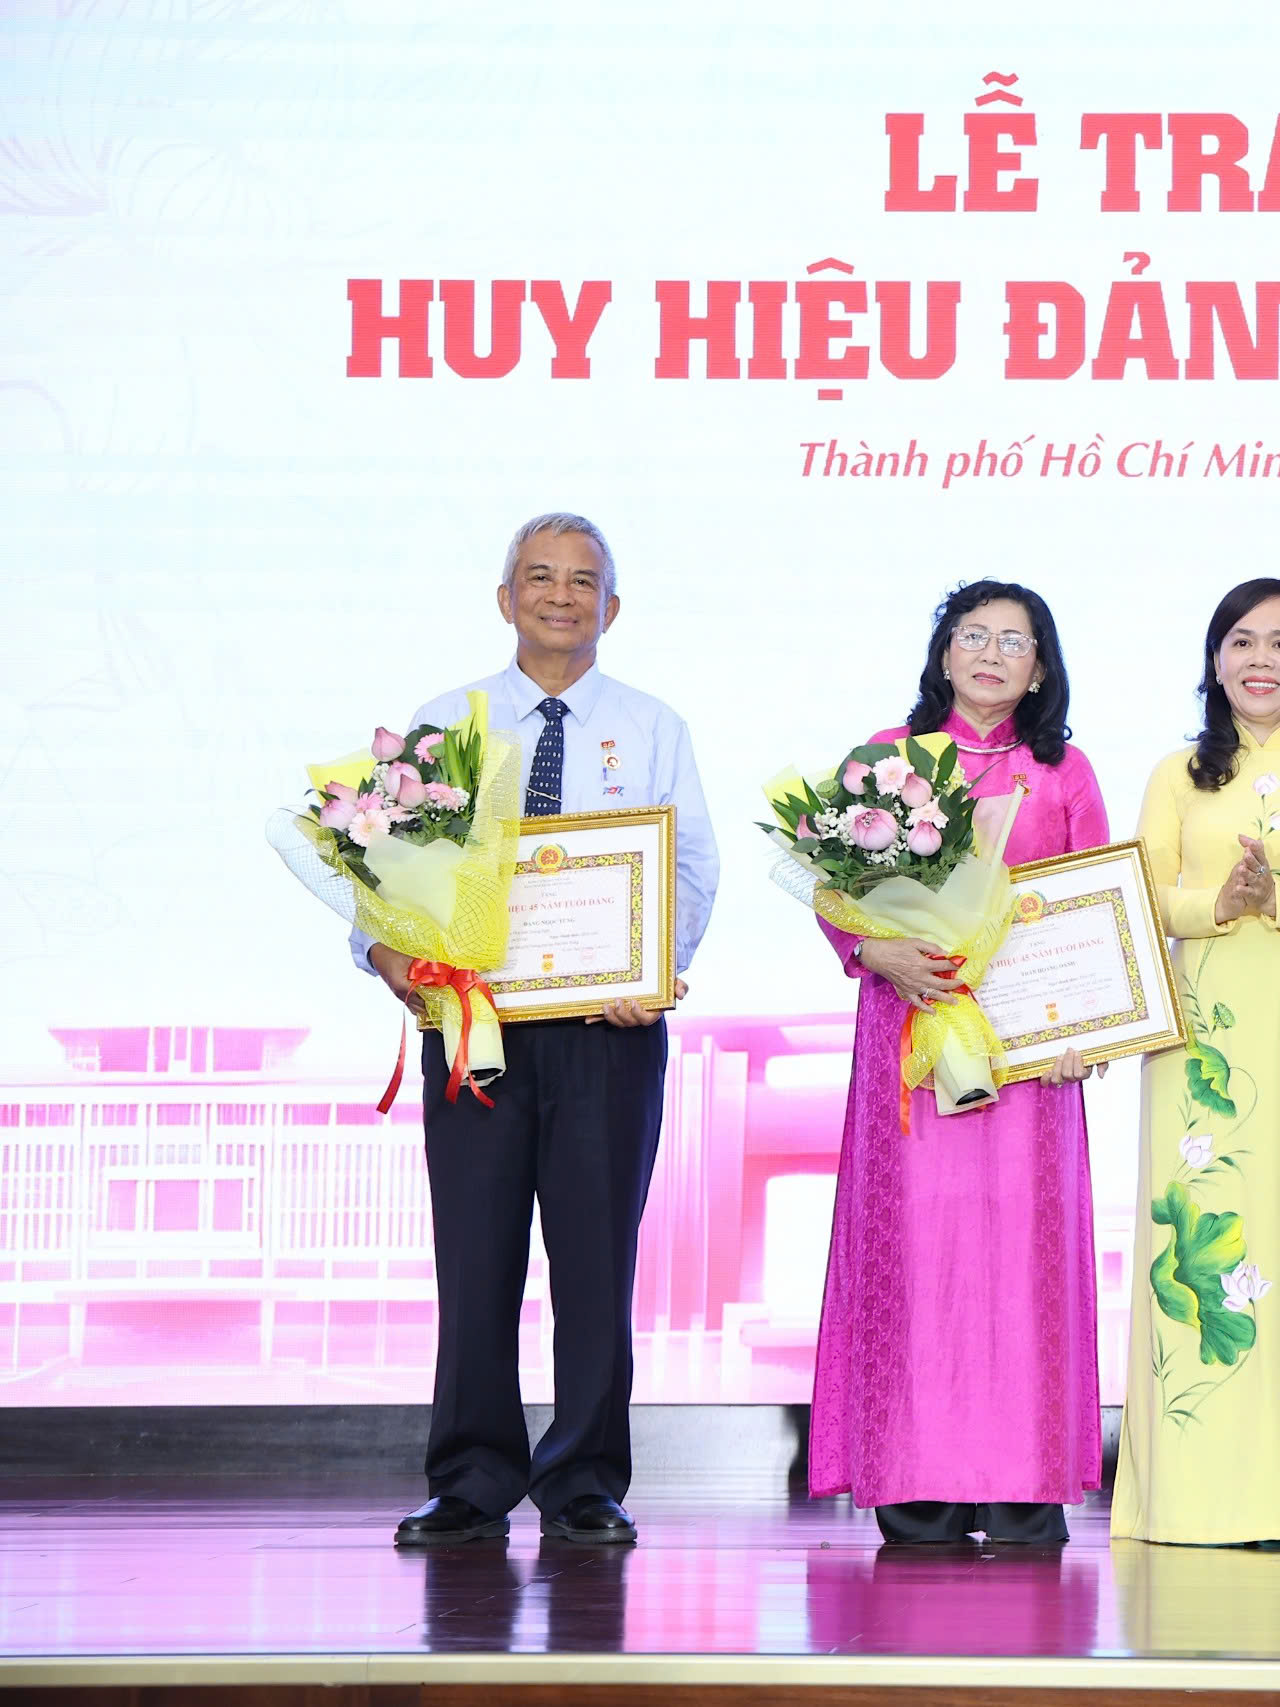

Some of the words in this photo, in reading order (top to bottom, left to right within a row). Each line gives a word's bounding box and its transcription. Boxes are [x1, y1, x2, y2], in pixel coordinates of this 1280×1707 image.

[885, 72, 1039, 212] LỄ
[346, 278, 612, 380] HUY
[655, 258, 961, 401] HIỆU
[800, 439, 928, 478] Thành
[942, 434, 1035, 489] phố
[1040, 434, 1104, 478] Hồ
[1117, 440, 1195, 478] Chí
[529, 903, 538, 911] 45
